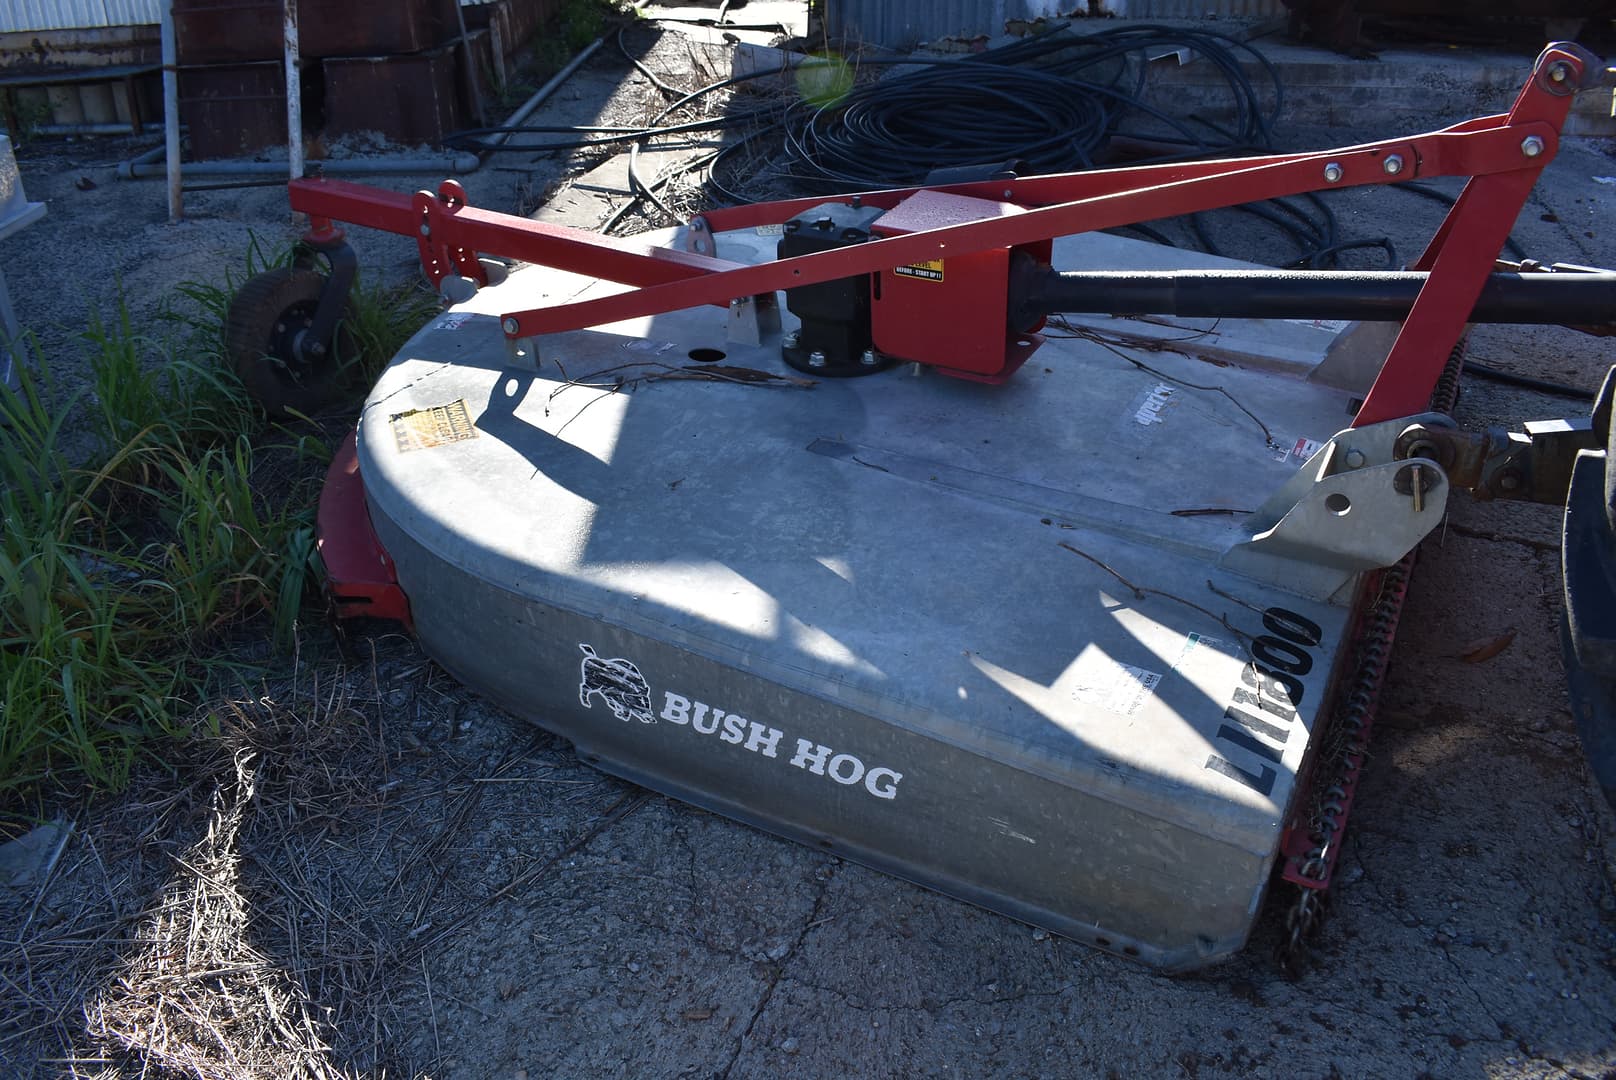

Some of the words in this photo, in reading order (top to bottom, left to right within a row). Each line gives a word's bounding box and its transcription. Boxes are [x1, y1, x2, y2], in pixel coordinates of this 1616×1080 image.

[915, 269, 930, 277] START
[446, 401, 471, 441] WARNING
[660, 691, 784, 758] BUSH
[790, 738, 903, 800] HOG
